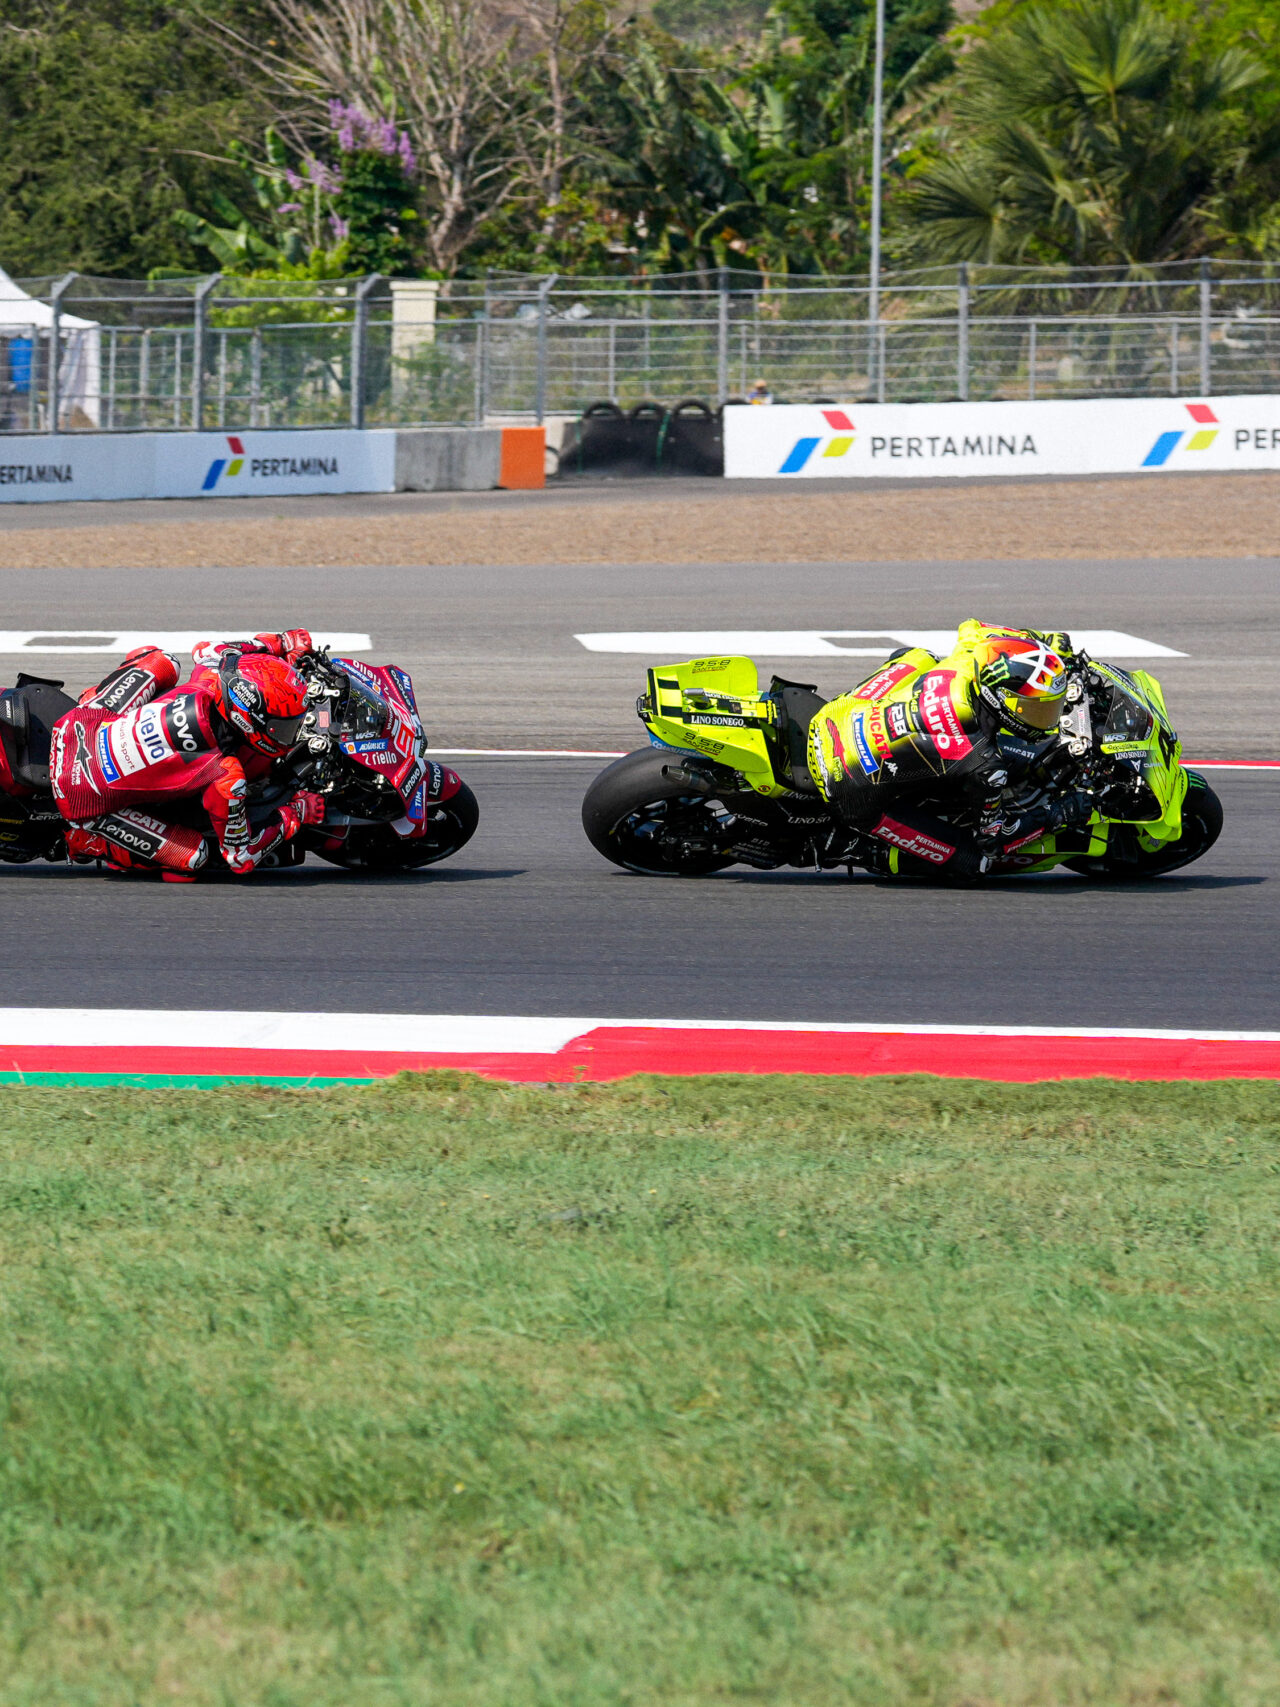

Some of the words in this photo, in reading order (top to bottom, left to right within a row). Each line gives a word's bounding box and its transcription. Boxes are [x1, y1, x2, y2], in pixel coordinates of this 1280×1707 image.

[872, 435, 1038, 458] PERTAMINA
[251, 457, 338, 477] PERTAMINA
[104, 672, 144, 707] Lenovo
[232, 685, 251, 707] Galicia
[237, 681, 257, 704] Estrella
[172, 695, 197, 751] novo
[233, 714, 251, 731] SHOEI
[691, 715, 711, 724] LINO
[712, 716, 744, 727] SONEGO
[940, 696, 965, 746] PERTAMINA
[99, 731, 113, 775] MICHELIN
[121, 741, 135, 770] Sport
[359, 742, 385, 751] ADVANCE
[854, 721, 872, 766] MICHELIN
[372, 751, 397, 765] riello
[401, 768, 420, 798] Lenovo
[98, 818, 152, 851] Lenovo
[876, 825, 944, 862] Enduro
[915, 835, 951, 854] PERTAMINA
